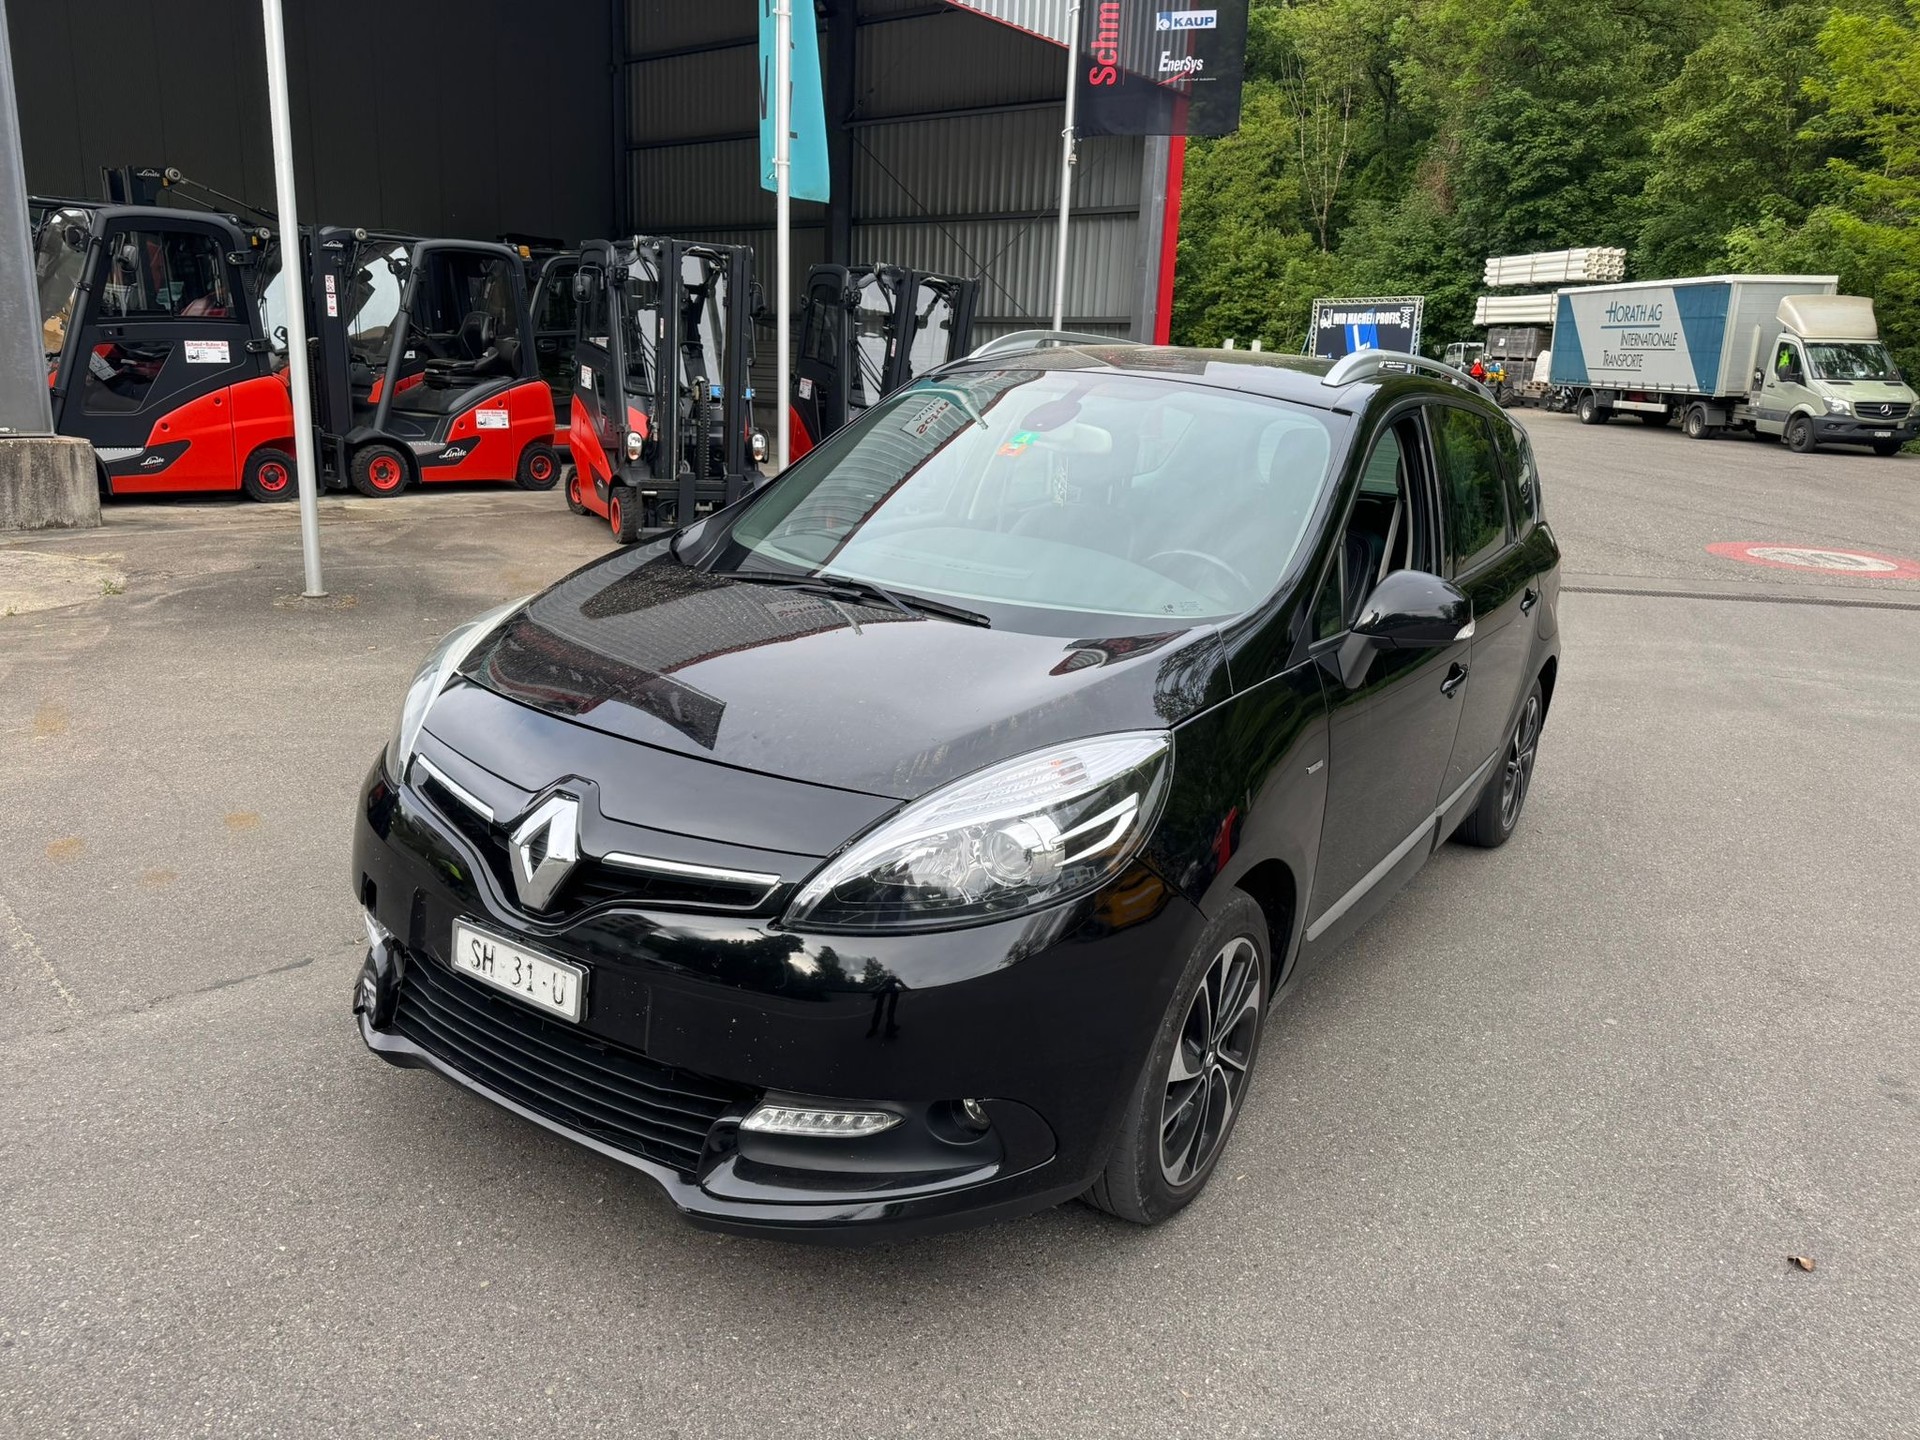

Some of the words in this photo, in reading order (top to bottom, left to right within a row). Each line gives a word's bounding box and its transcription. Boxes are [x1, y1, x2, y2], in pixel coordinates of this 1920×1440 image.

[1173, 16, 1215, 27] KAUP
[1159, 51, 1203, 74] EnerSys
[1333, 312, 1347, 324] WIR
[1605, 301, 1647, 322] HORATH
[1647, 303, 1662, 321] AG
[1620, 330, 1678, 347] INTERNATIONALE
[1602, 350, 1644, 367] TRANSPORTE
[140, 456, 165, 466] Linde
[438, 446, 467, 459] Linde
[470, 939, 496, 976] SH
